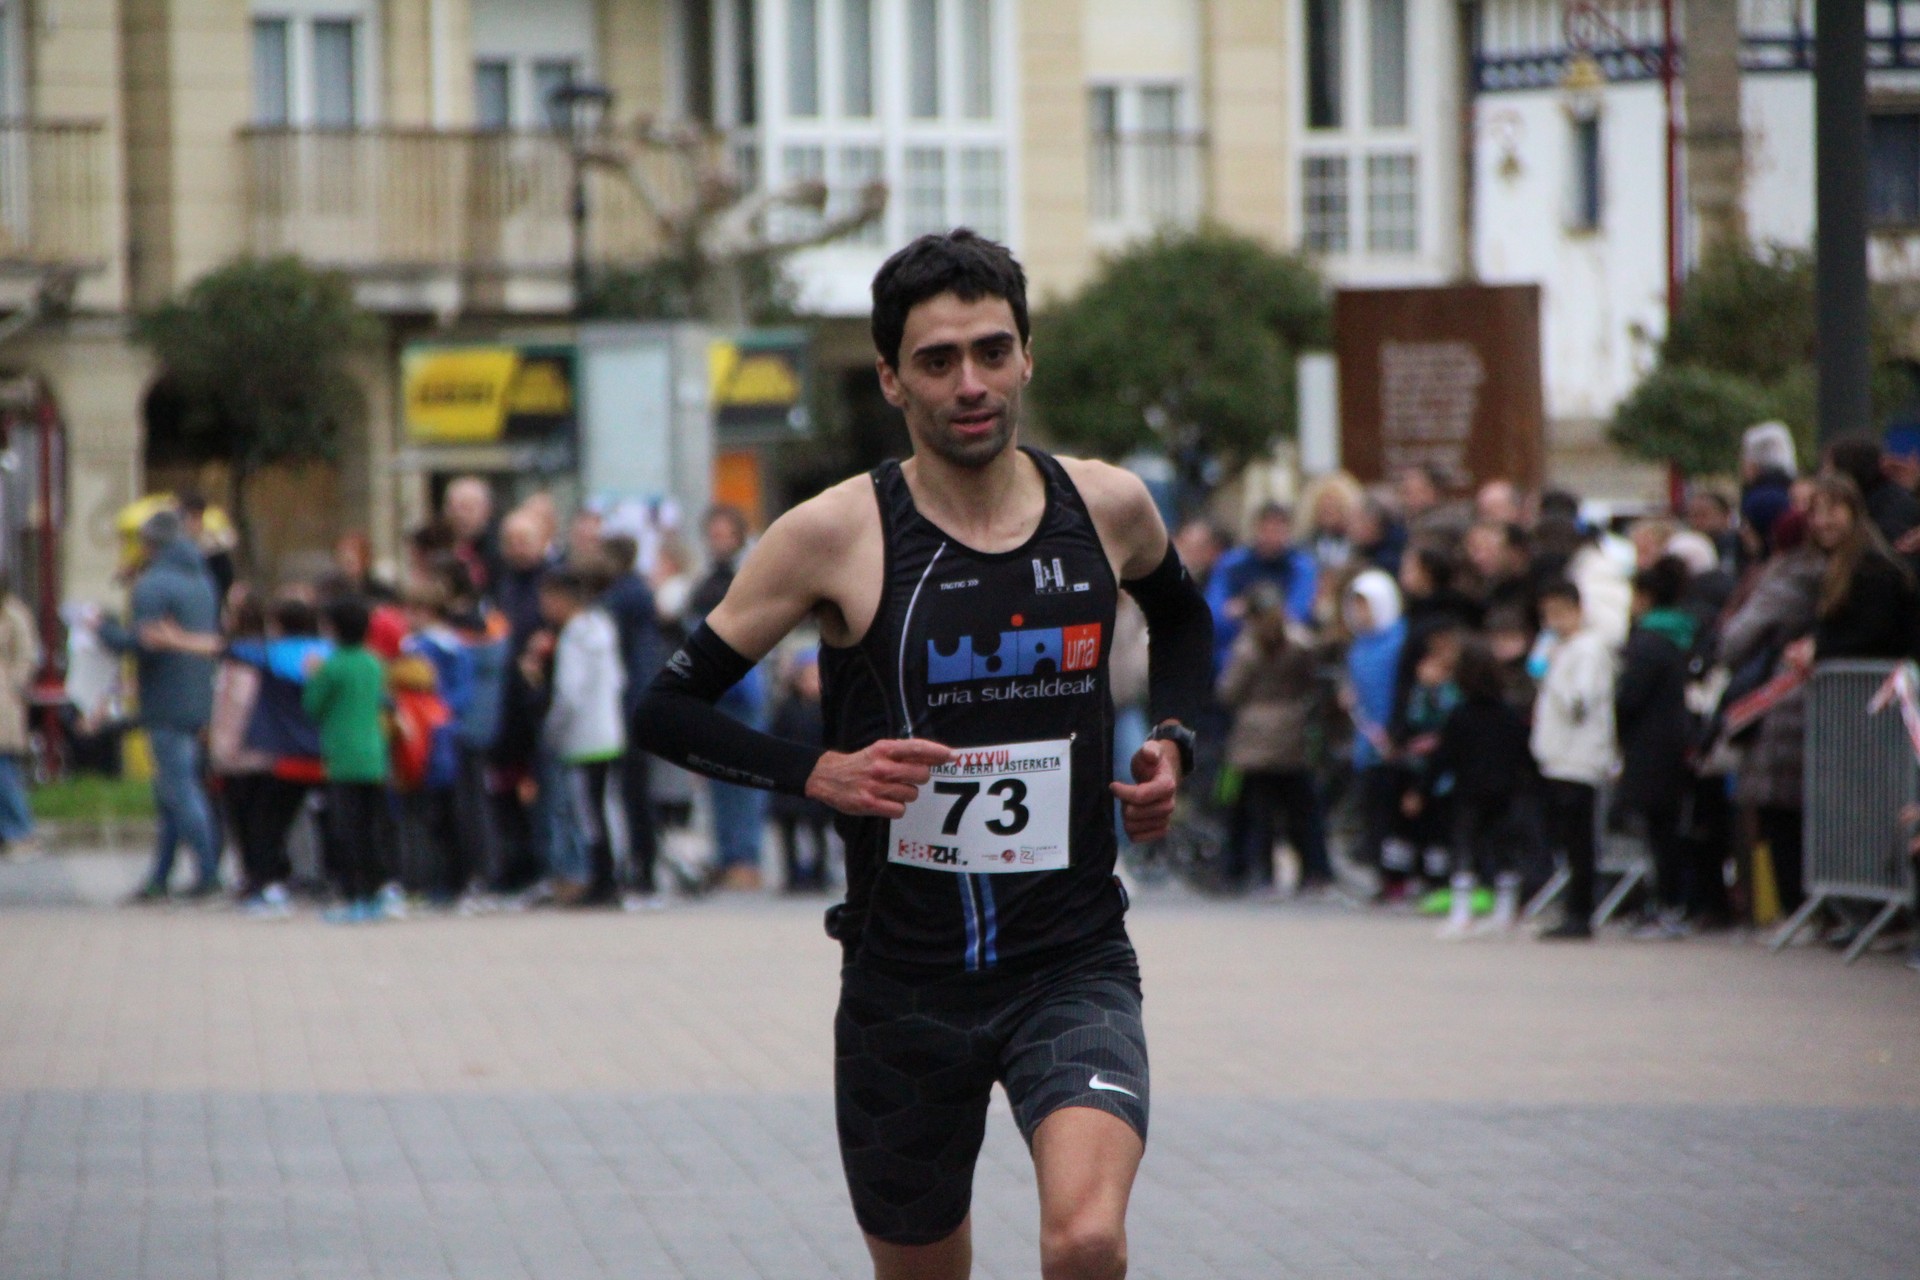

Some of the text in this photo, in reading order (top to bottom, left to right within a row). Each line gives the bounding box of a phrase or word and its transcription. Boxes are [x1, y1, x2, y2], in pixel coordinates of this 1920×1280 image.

[927, 674, 1096, 707] uria sukaldeak
[962, 762, 994, 775] HERRI
[999, 756, 1061, 773] LASTERKETA
[934, 778, 1030, 836] 73
